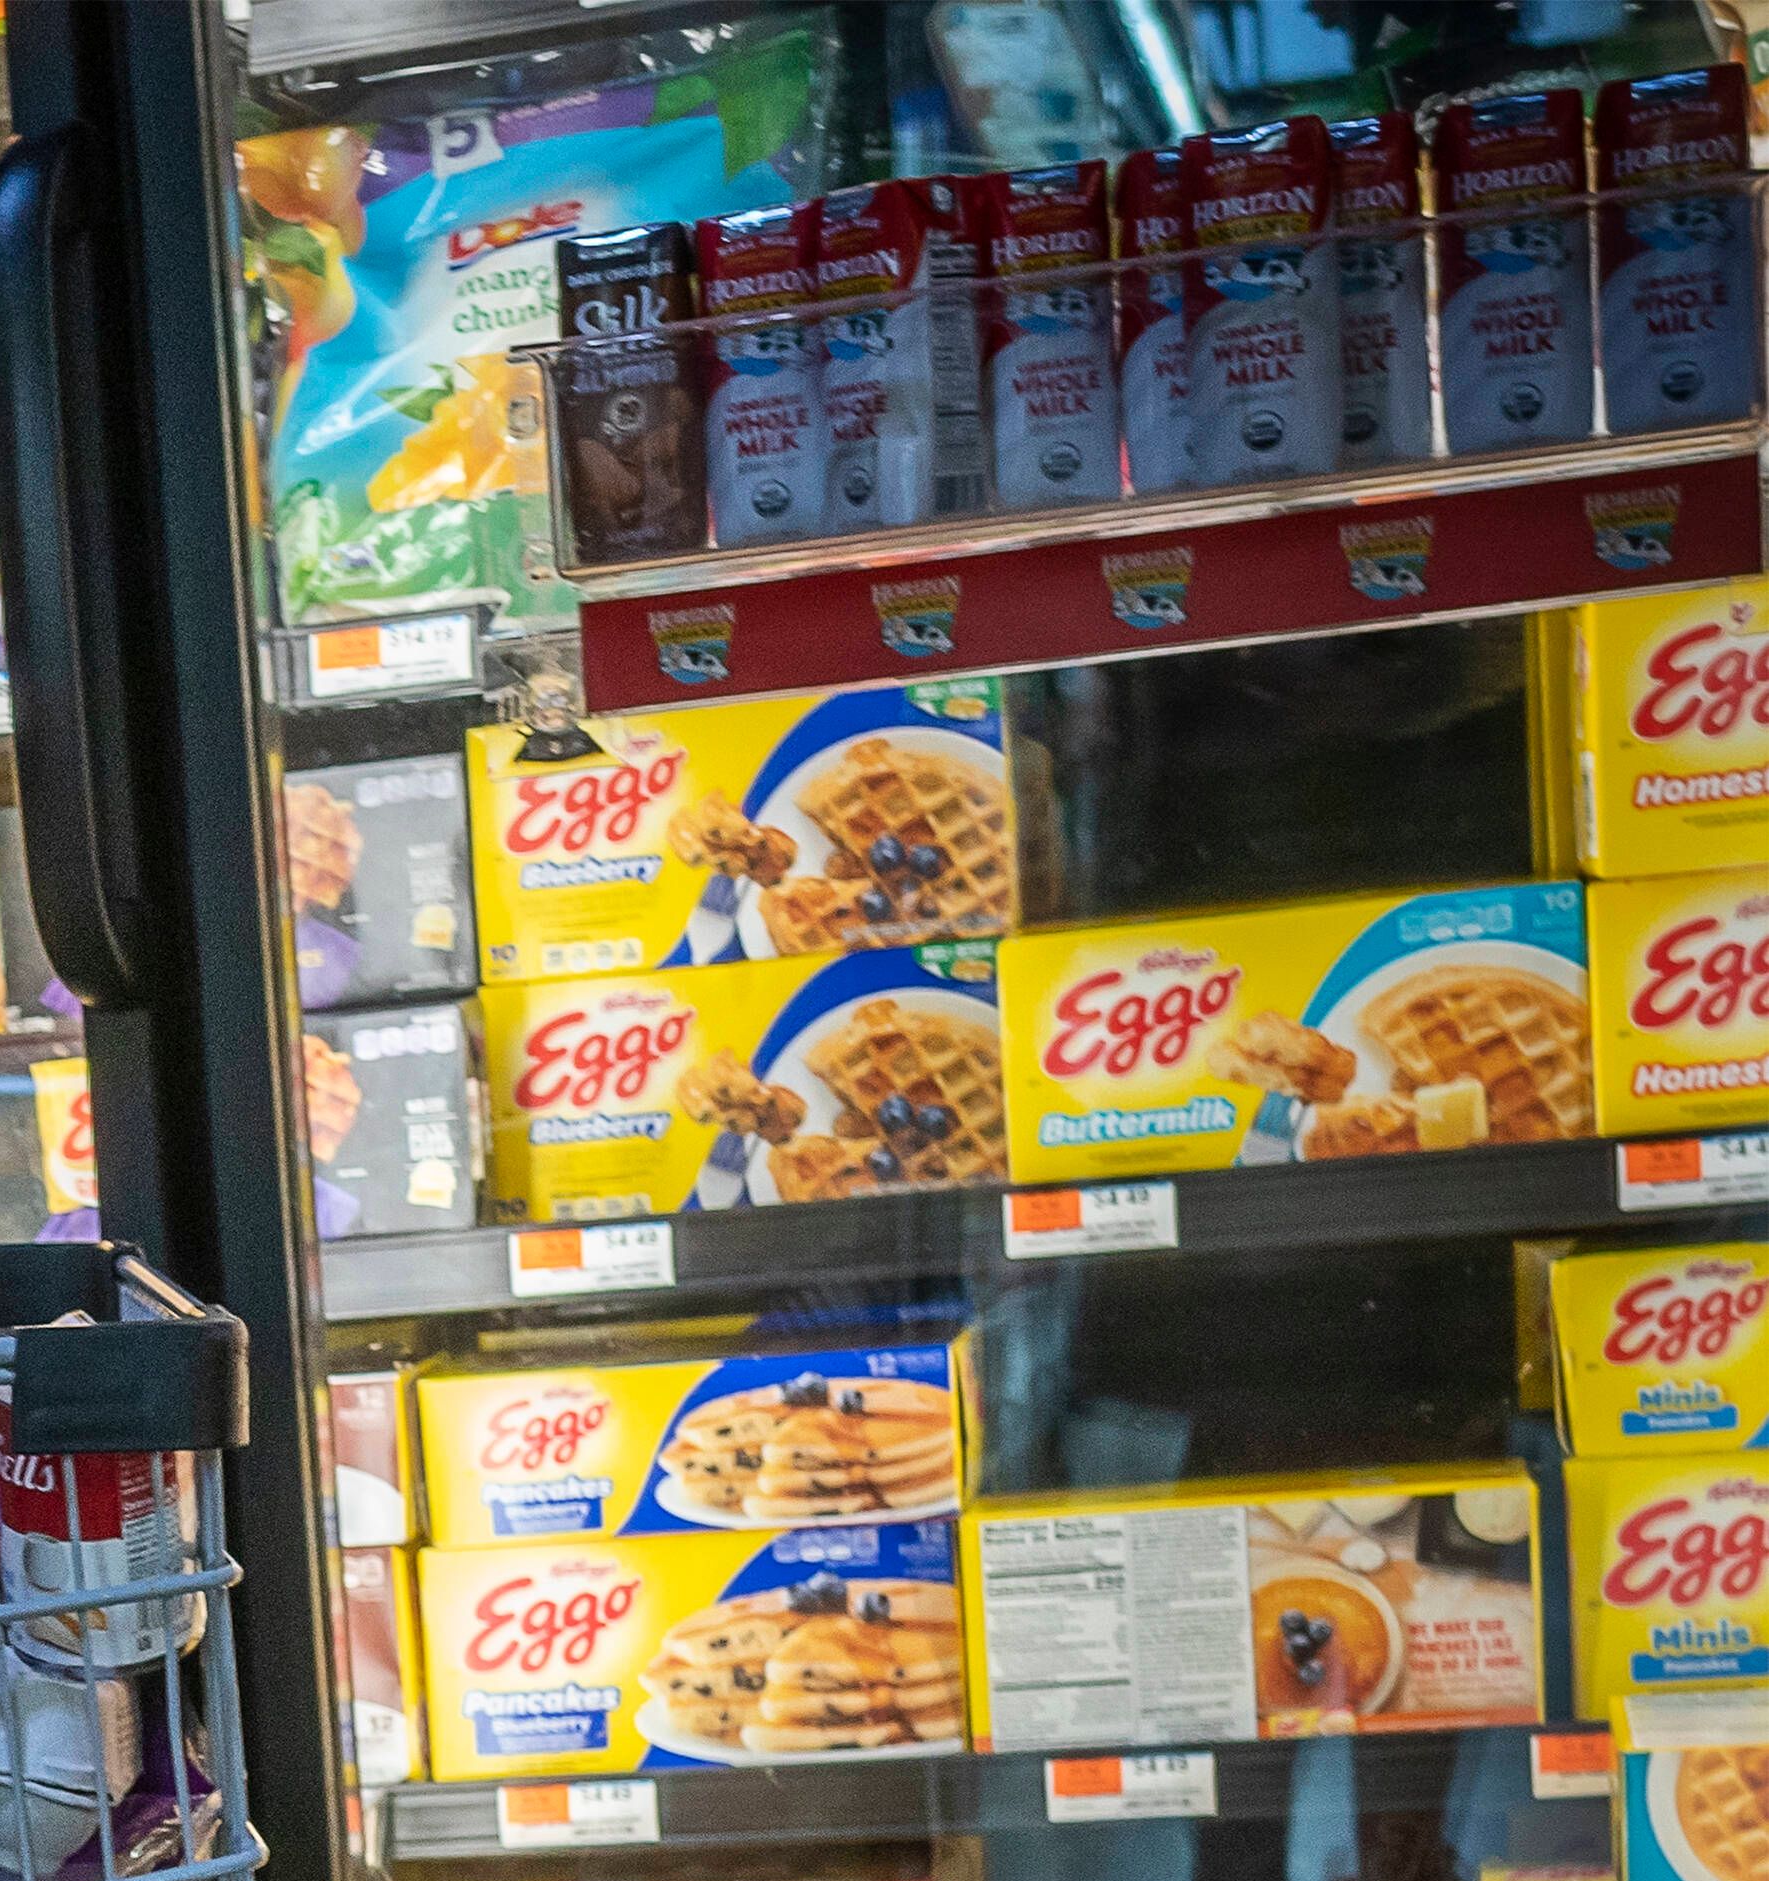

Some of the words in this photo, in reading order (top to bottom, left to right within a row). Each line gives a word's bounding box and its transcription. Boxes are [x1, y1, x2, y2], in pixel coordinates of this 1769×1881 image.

[1611, 136, 1741, 178] HORIZON
[1453, 159, 1575, 193] HORIZON
[1191, 184, 1318, 217] HORIZON
[990, 227, 1104, 268] HORIZON
[706, 266, 816, 305] HORIZON
[574, 285, 670, 336] Silk
[1212, 333, 1305, 364] WHOLE
[1483, 332, 1555, 359] MILK
[1012, 369, 1102, 396] WHOLE
[1225, 360, 1293, 388] MILK
[725, 404, 811, 435] WHOLE
[1025, 393, 1093, 418] MILK
[735, 432, 800, 458] MILK
[504, 749, 688, 855] Eggo
[520, 853, 663, 890] Blueberry
[1042, 965, 1242, 1080] Eggo
[514, 1008, 695, 1111] Eggo
[528, 1112, 671, 1144] Blueberry
[1038, 1096, 1237, 1147] Buttermilk
[1602, 1276, 1768, 1368] Eggo
[1637, 1382, 1722, 1411] Minis
[479, 1399, 610, 1471] Eggo
[481, 1475, 613, 1508] Pancakes
[463, 1576, 643, 1676] Eggo
[1651, 1618, 1752, 1653] Minis
[463, 1684, 622, 1718] Pancakes
[492, 1711, 593, 1738] Blueberry
